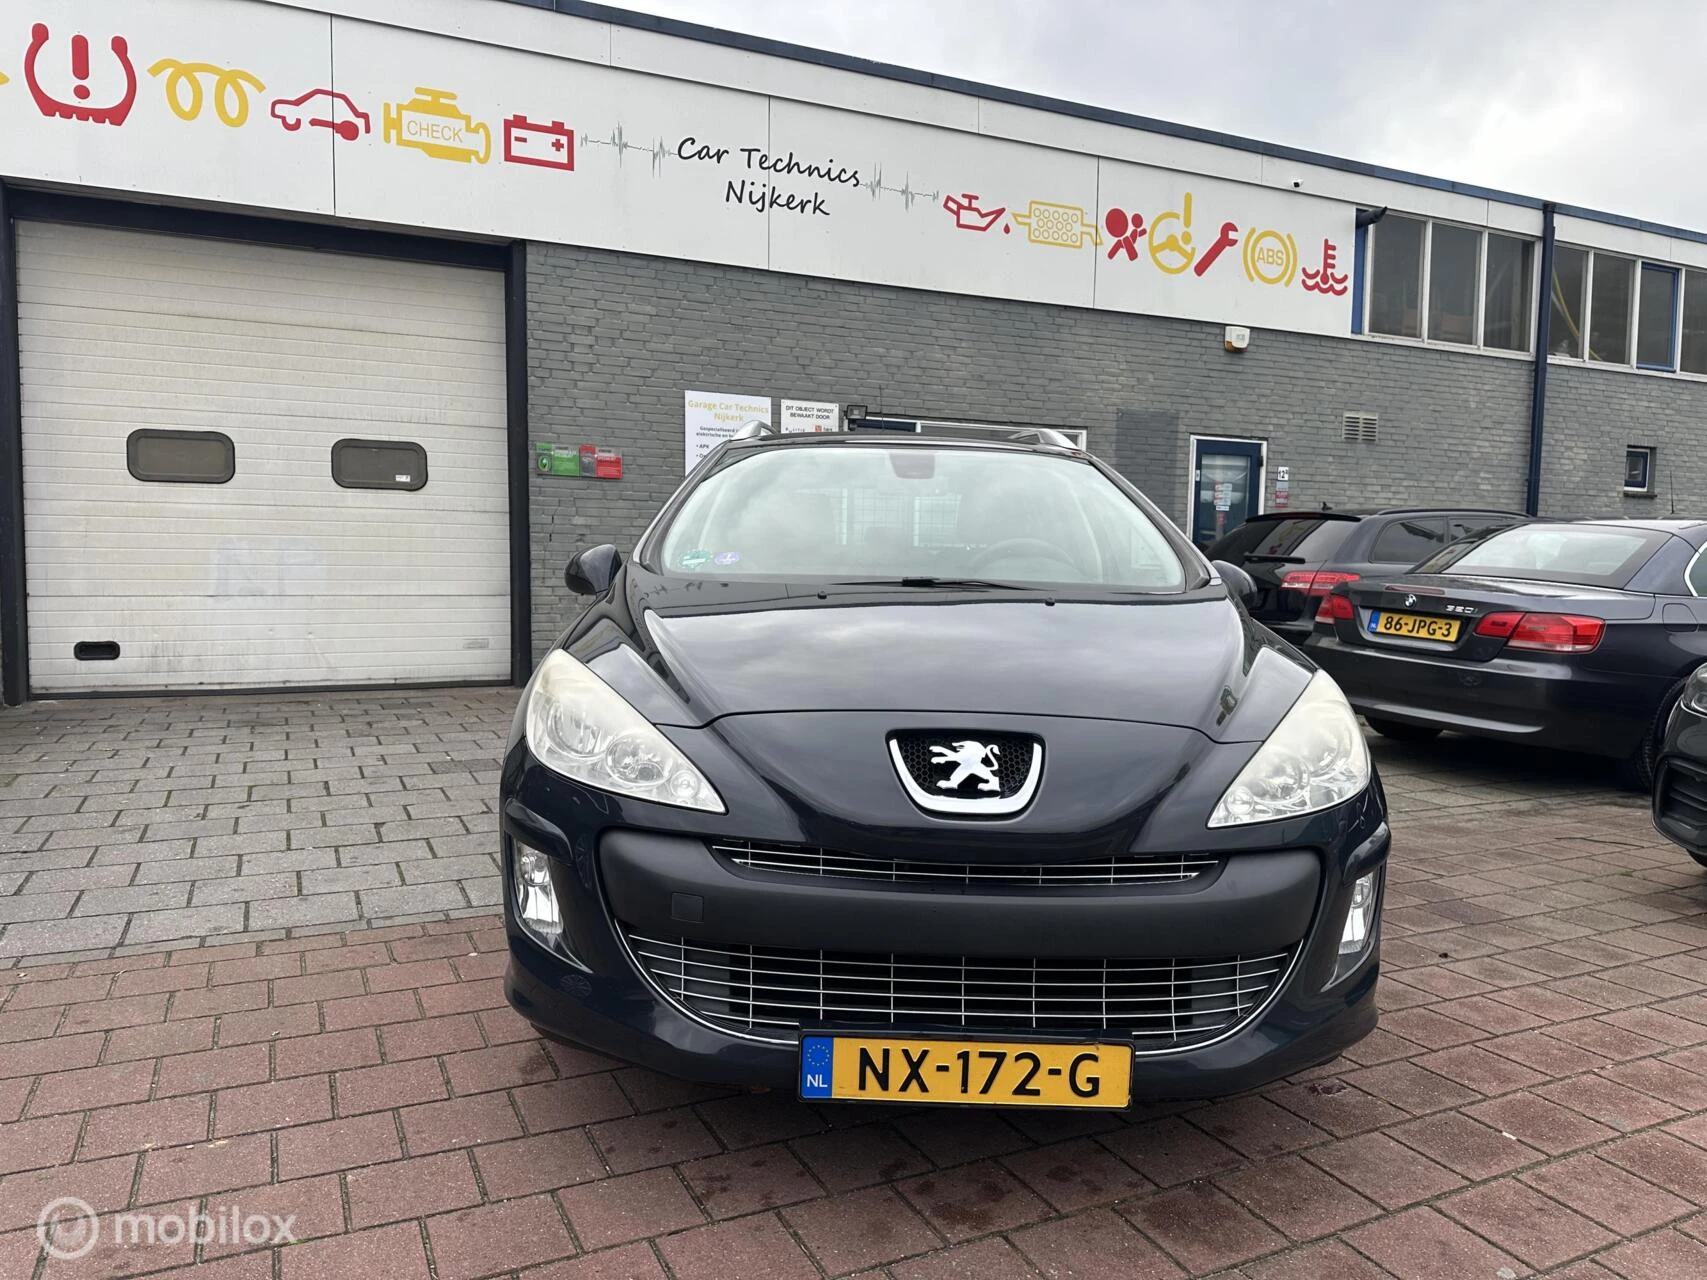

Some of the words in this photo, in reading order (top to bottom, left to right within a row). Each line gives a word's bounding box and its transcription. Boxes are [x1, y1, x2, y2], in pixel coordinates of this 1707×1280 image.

[407, 119, 464, 144] CHECK
[677, 136, 730, 164] Car
[739, 148, 861, 188] Technics
[725, 179, 831, 216] Nijkerk
[1256, 246, 1285, 267] ABS
[688, 400, 717, 411] Garage
[719, 402, 732, 411] Car
[735, 403, 769, 414] Technics
[714, 412, 744, 422] Nijkerk
[1383, 615, 1453, 638] 86-JPG-3
[806, 1073, 828, 1088] NL
[858, 1046, 1101, 1098] NX-172-G
